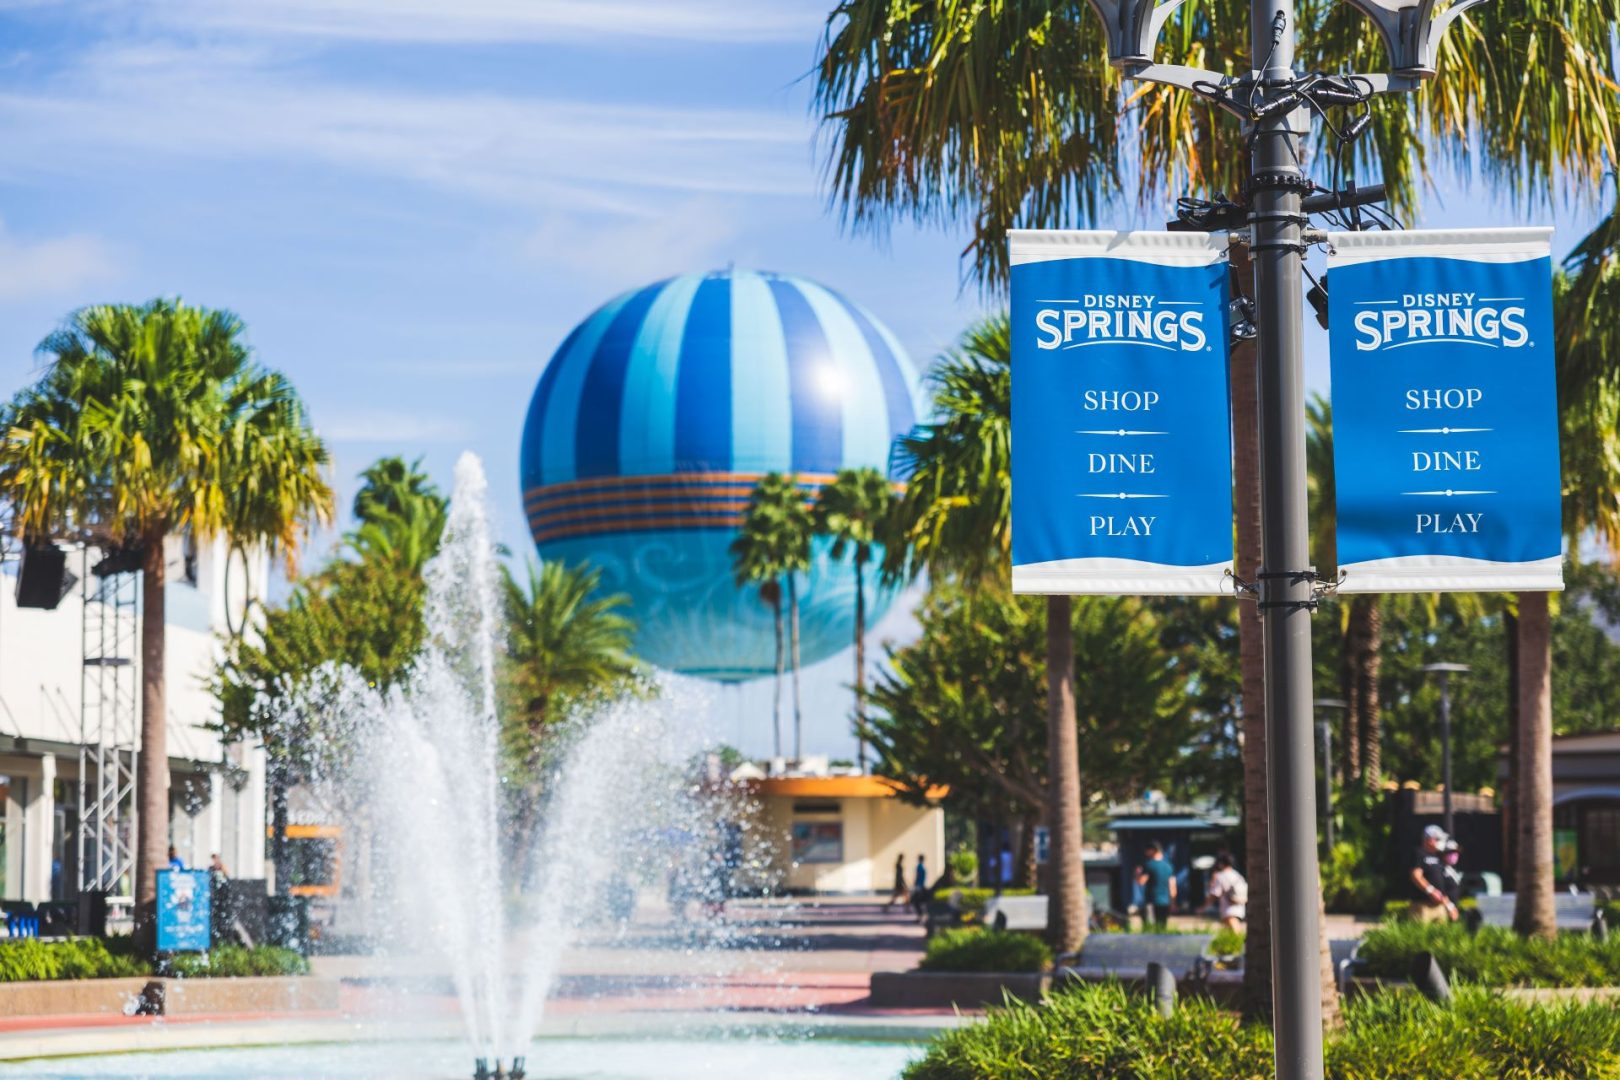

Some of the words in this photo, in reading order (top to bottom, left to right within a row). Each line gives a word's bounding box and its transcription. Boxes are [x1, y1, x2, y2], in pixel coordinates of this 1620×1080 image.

[1084, 294, 1155, 309] DISNEY
[1403, 292, 1475, 307] DISNEY
[1084, 390, 1159, 411] SHOP
[1407, 388, 1483, 410] SHOP
[1088, 453, 1155, 474] DINE
[1413, 450, 1481, 471] DINE
[1090, 516, 1156, 536] PLAY
[1416, 513, 1483, 534] PLAY
